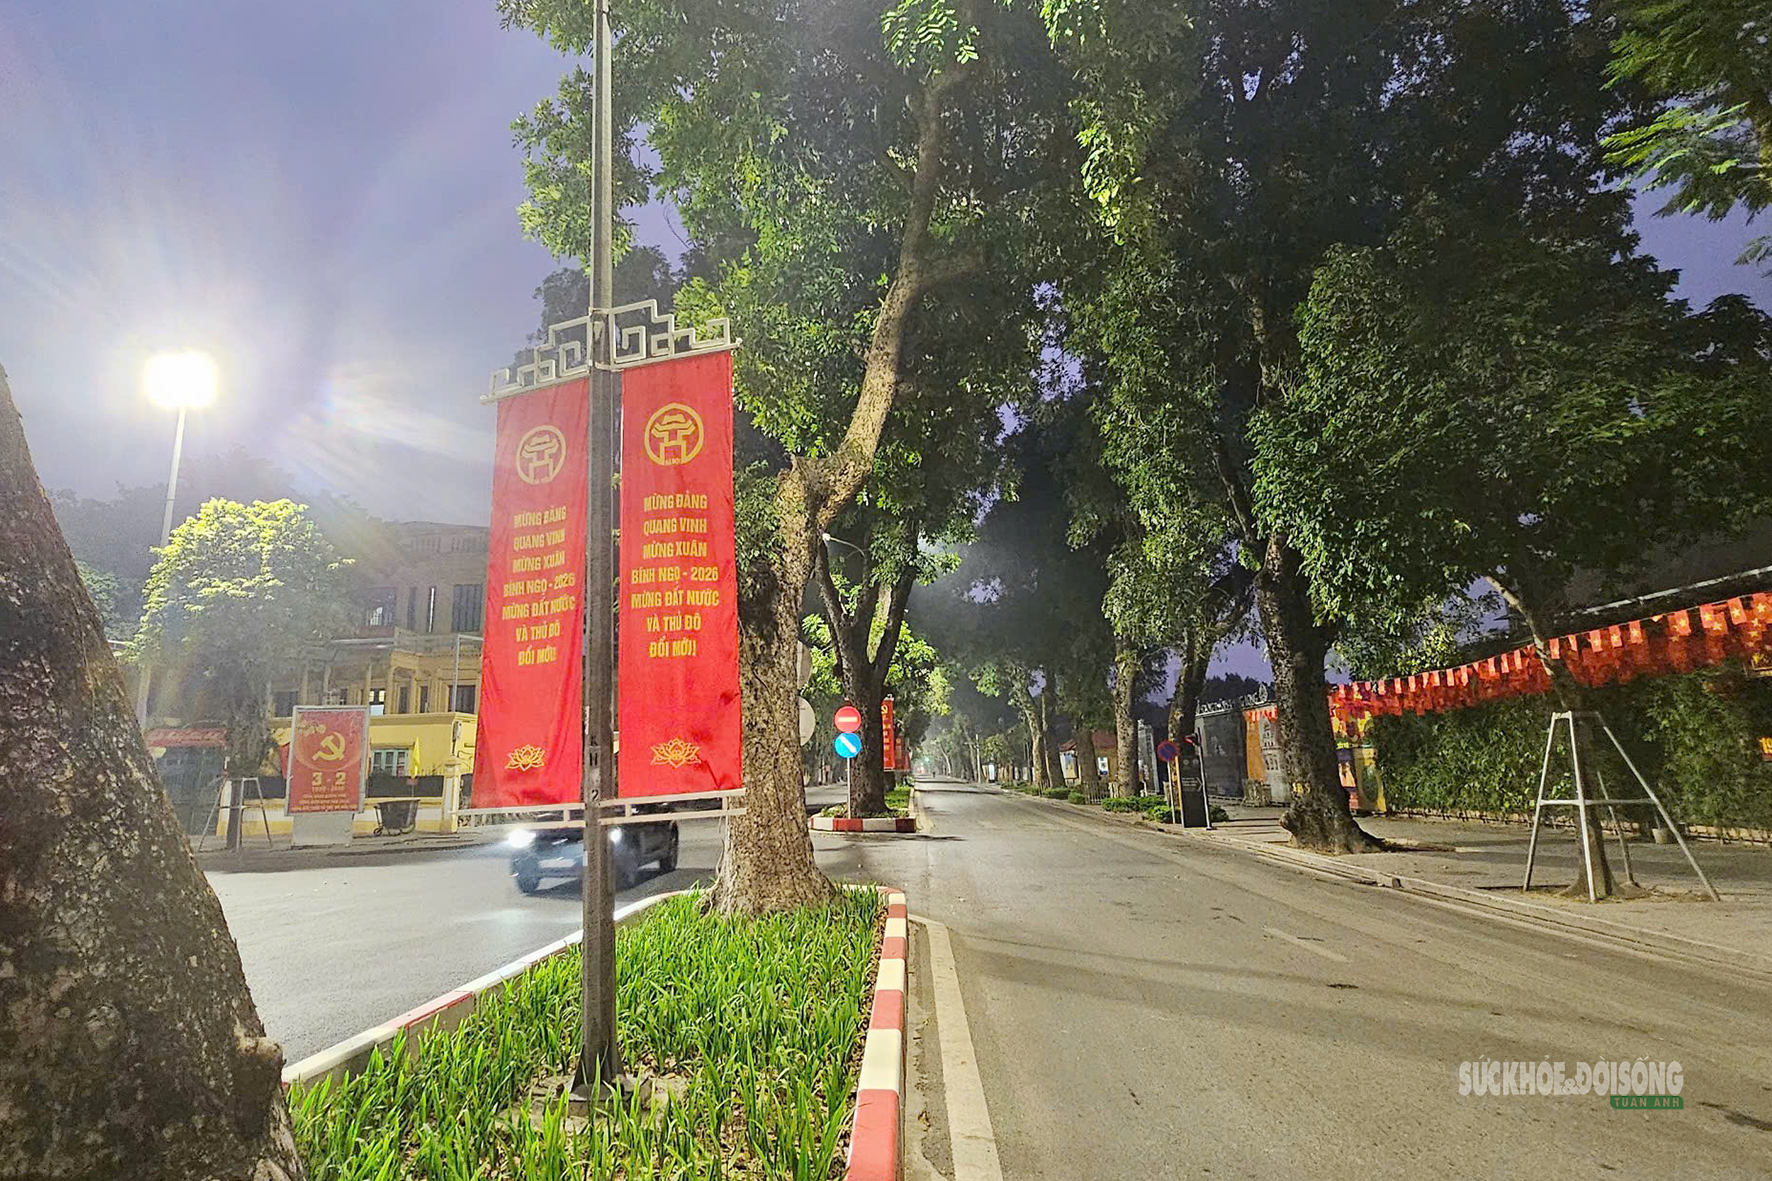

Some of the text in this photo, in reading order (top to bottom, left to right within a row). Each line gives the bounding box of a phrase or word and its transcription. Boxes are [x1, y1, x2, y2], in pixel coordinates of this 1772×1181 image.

[643, 490, 708, 512] MỪNG ĐẢNG
[643, 517, 708, 536] QUANG VINH
[513, 534, 545, 552] QUANG
[643, 539, 708, 560] MỪNG XUÂN
[631, 566, 655, 584] BÍNH
[658, 565, 681, 584] NGỌ
[690, 566, 719, 582] 2026
[526, 578, 548, 596] NGỌ
[631, 585, 720, 609] MỪNG ĐẤT NƯỚC
[646, 610, 702, 632] VÀ THỦ ĐÔ
[515, 623, 528, 643] VÀ
[649, 636, 669, 658] ĐỔI
[311, 771, 323, 787] 3
[335, 771, 346, 786] 2
